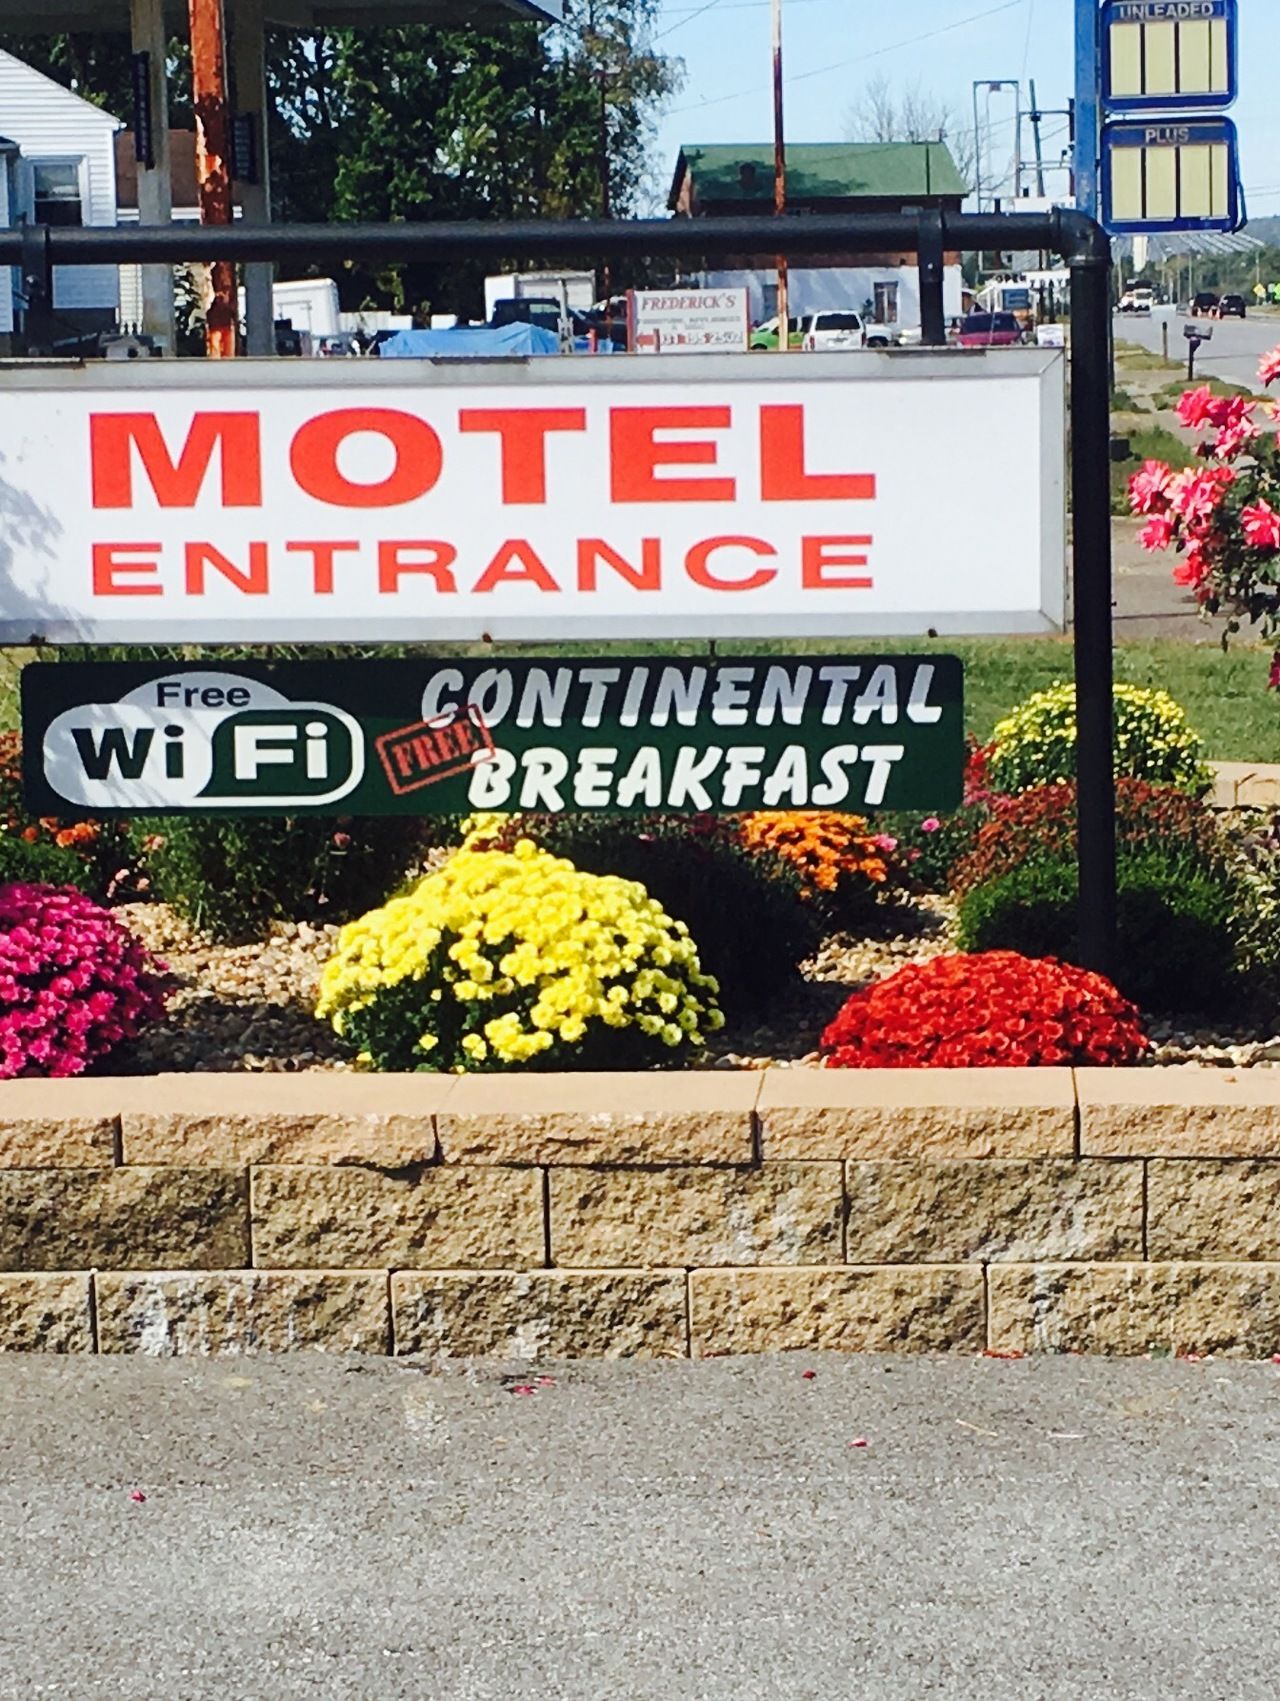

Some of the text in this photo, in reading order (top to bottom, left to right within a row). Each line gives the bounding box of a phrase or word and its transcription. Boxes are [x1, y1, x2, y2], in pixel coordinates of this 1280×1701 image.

[1121, 2, 1214, 19] UNLEADED
[1145, 127, 1190, 143] PLUS
[641, 293, 737, 311] FREDERICK'S
[90, 405, 875, 509] MOTEL
[92, 535, 873, 597] ENTRANCE
[156, 682, 251, 707] Free
[421, 664, 943, 729] CONTINENTAL
[392, 716, 484, 778] FREE
[468, 744, 905, 812] BREAKFAST
